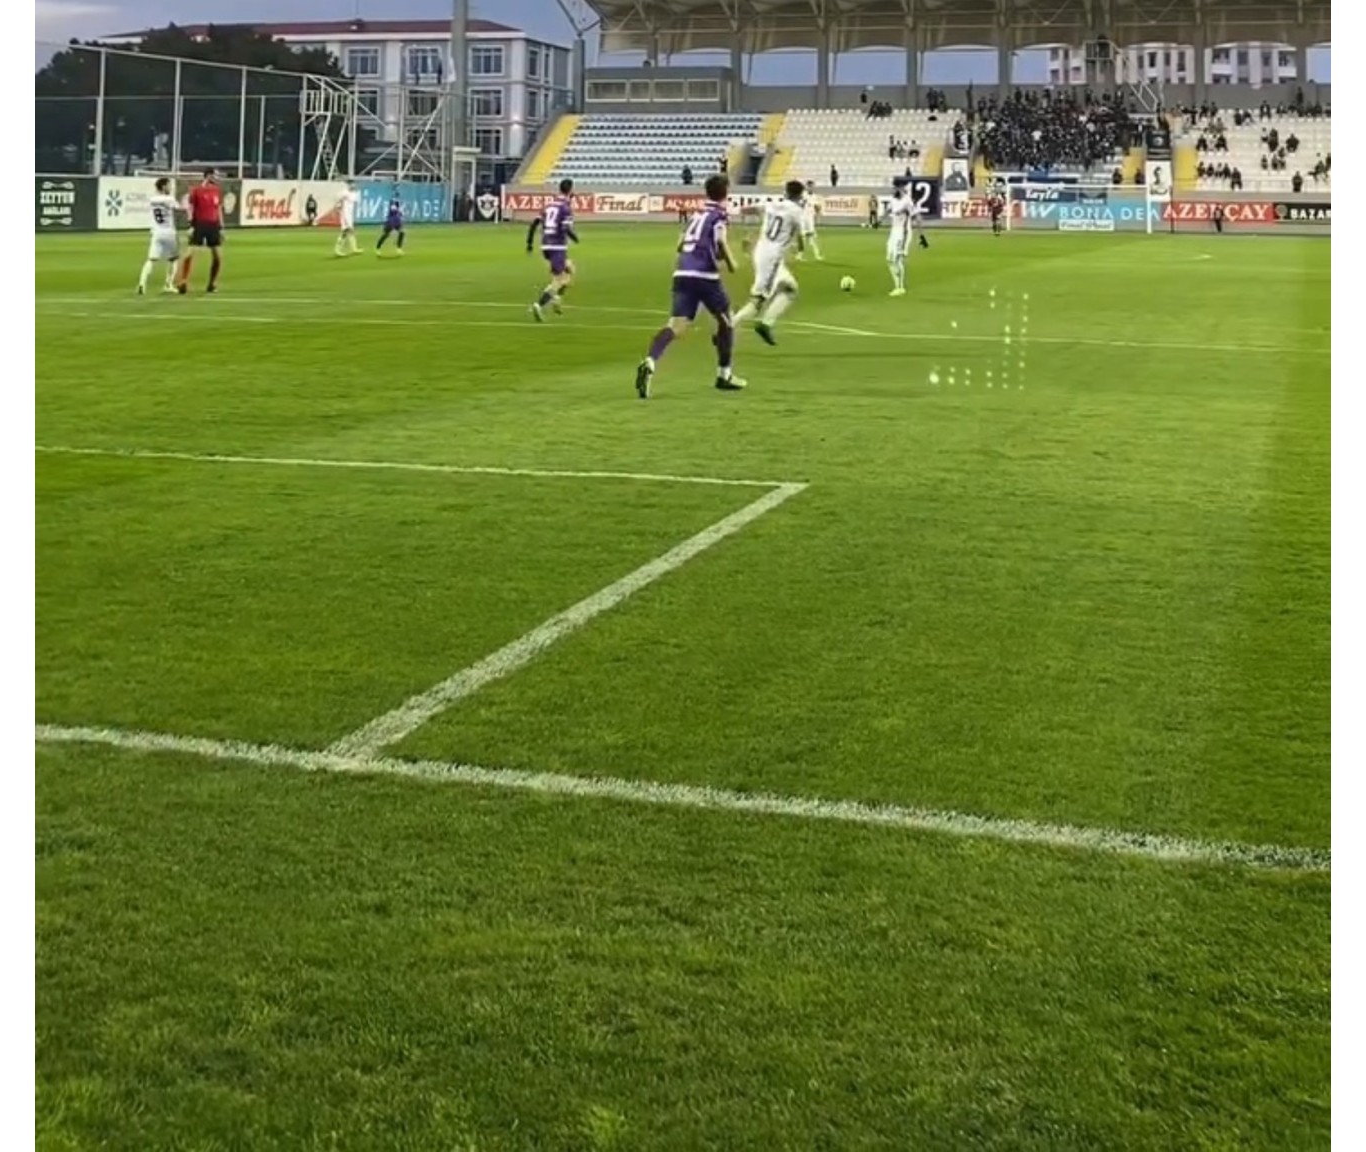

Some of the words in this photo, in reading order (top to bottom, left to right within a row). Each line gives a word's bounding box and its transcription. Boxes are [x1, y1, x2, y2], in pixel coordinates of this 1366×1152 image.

[246, 187, 297, 220] Final
[596, 195, 647, 211] Final
[1059, 206, 1115, 219] BONA
